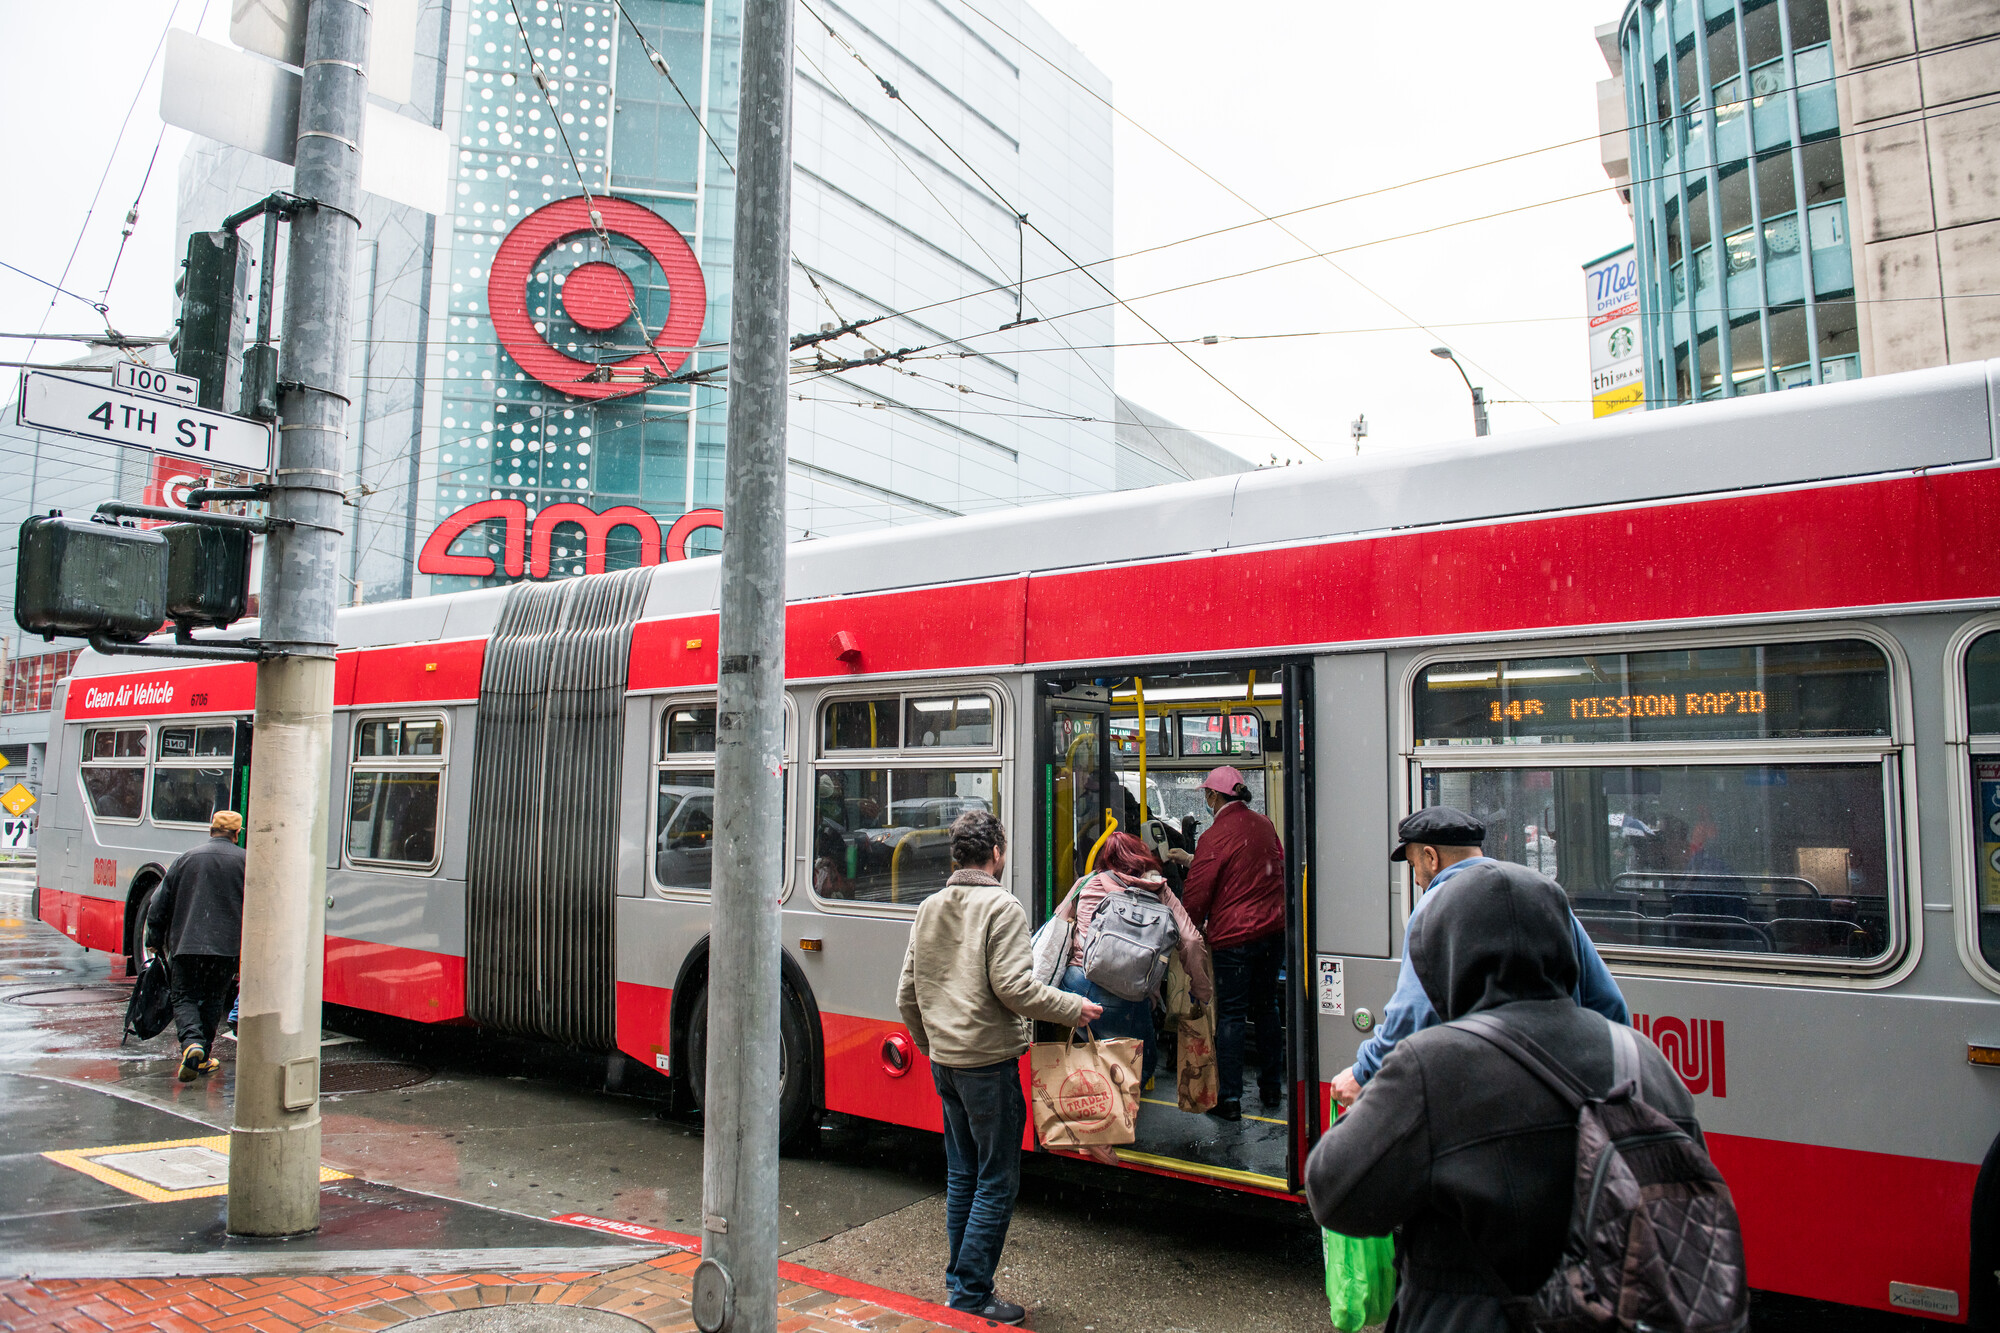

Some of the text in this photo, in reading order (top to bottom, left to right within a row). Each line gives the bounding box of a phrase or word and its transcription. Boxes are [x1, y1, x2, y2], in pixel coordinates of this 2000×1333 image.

[129, 368, 167, 393] 100
[1593, 370, 1614, 391] thi
[88, 401, 219, 452] 4TH ST
[85, 680, 209, 709] Clean Air Vehicle 6706
[1489, 690, 1767, 722] 14R MISSION RAPID
[1066, 1090, 1110, 1112] TRADER
[1076, 1102, 1107, 1120] JOE'S
